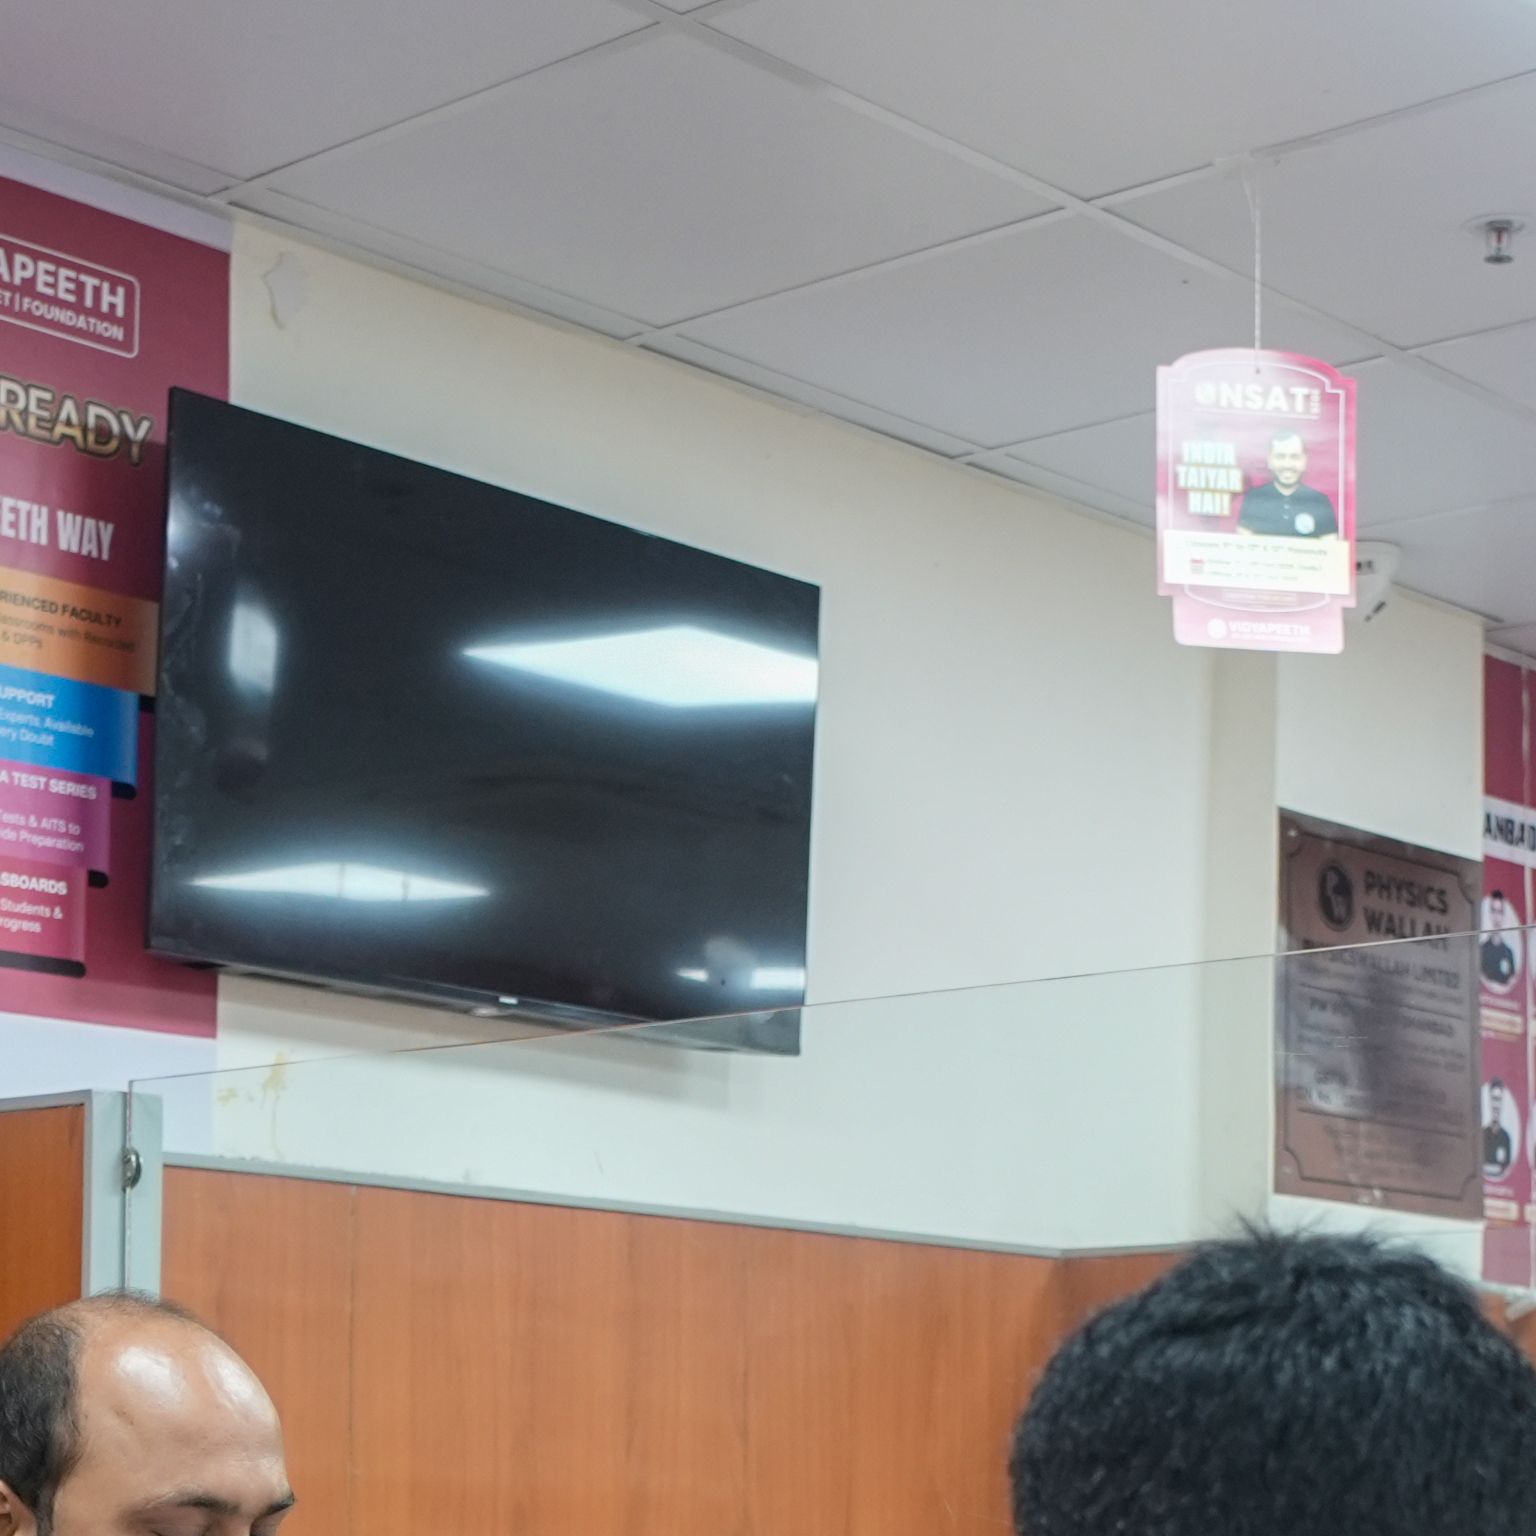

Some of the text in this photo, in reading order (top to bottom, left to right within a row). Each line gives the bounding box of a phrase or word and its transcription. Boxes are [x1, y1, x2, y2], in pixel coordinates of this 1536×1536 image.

[22, 297, 124, 341] FOUNDATION
[57, 510, 114, 561] WAY
[61, 603, 123, 628] FACULTY
[19, 727, 55, 747] Doubt
[11, 771, 47, 791] TEST
[48, 778, 97, 801] SERIES
[0, 896, 51, 917] Students
[1365, 869, 1449, 916] PHYSICS
